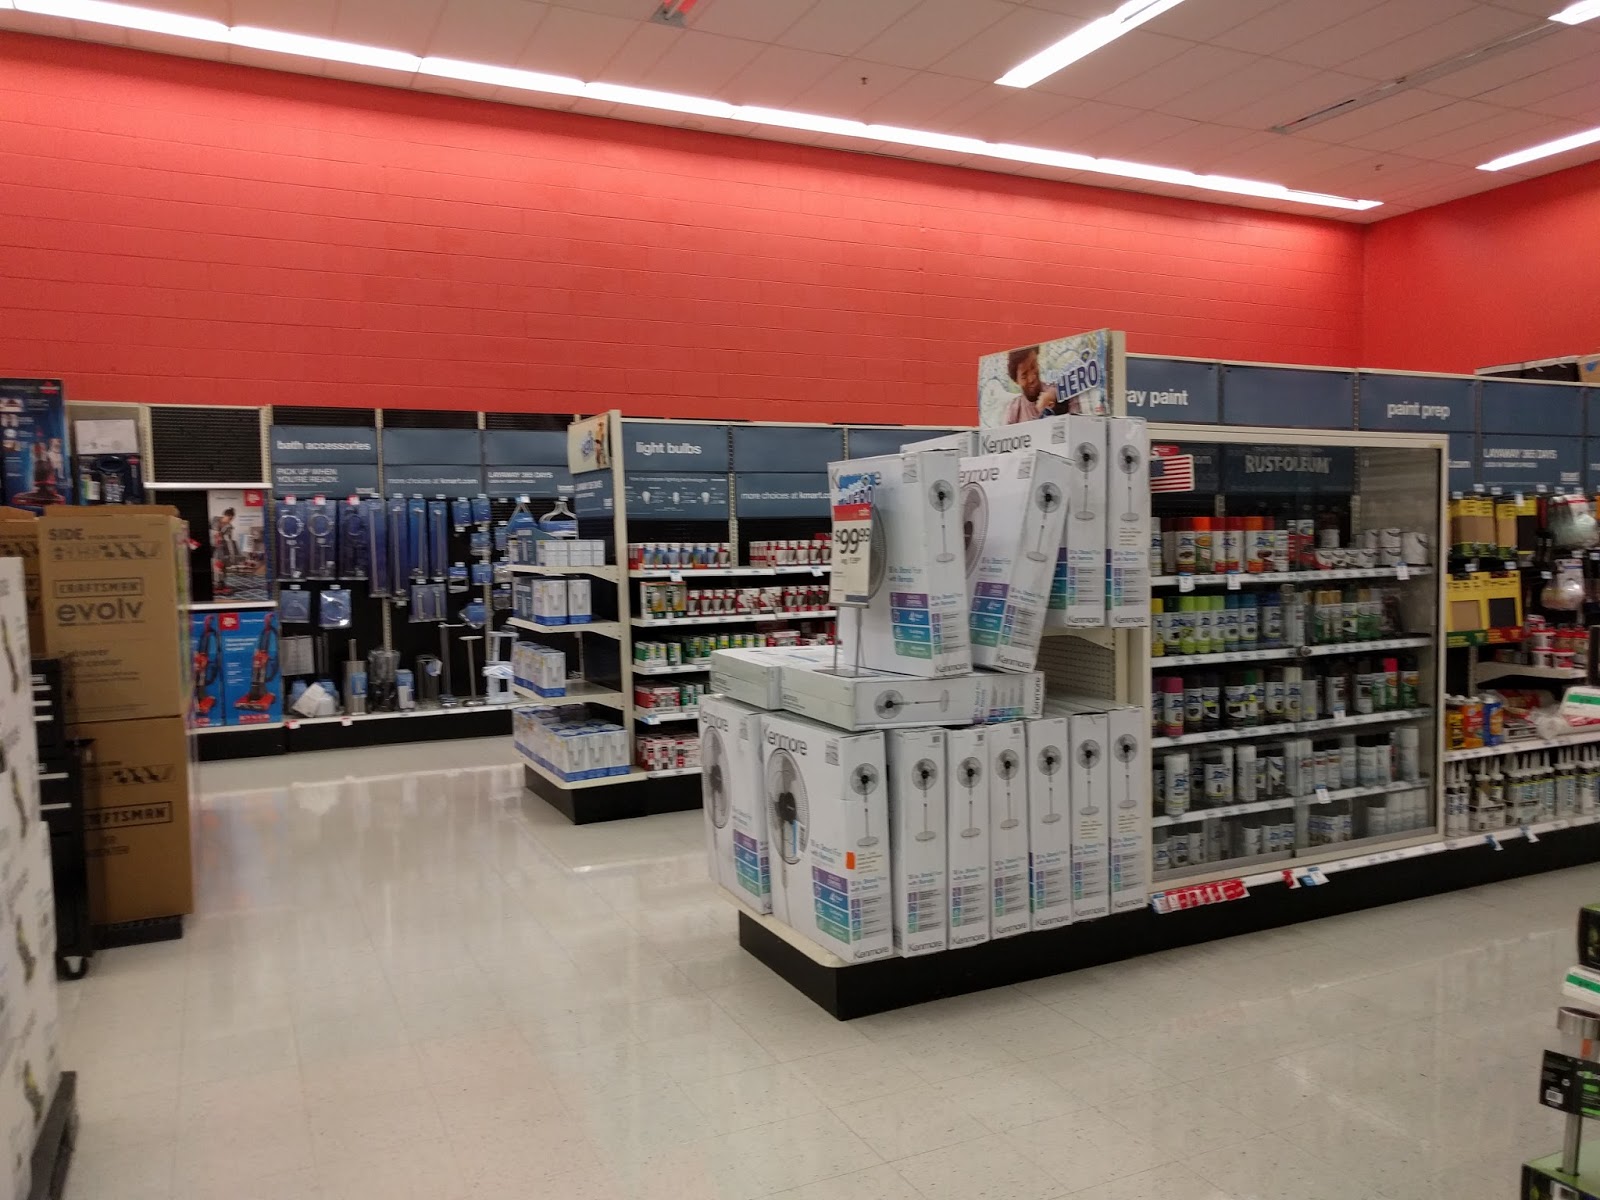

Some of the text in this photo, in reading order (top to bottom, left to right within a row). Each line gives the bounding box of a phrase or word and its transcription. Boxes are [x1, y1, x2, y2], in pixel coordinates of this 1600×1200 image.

[1057, 360, 1098, 401] HERO
[1125, 388, 1189, 408] ay paint
[1386, 401, 1451, 420] paint prep
[276, 440, 372, 451] bath accessories
[635, 441, 702, 456] light bulbs
[981, 434, 1032, 455] Kenmore
[958, 467, 1000, 483] enmore
[741, 492, 760, 500] more
[762, 491, 789, 500] choices
[57, 598, 144, 622] evolv
[935, 661, 969, 673] Kenmore
[701, 710, 729, 733] enmore
[762, 723, 808, 756] Kenmore
[853, 946, 890, 959] Kenmore
